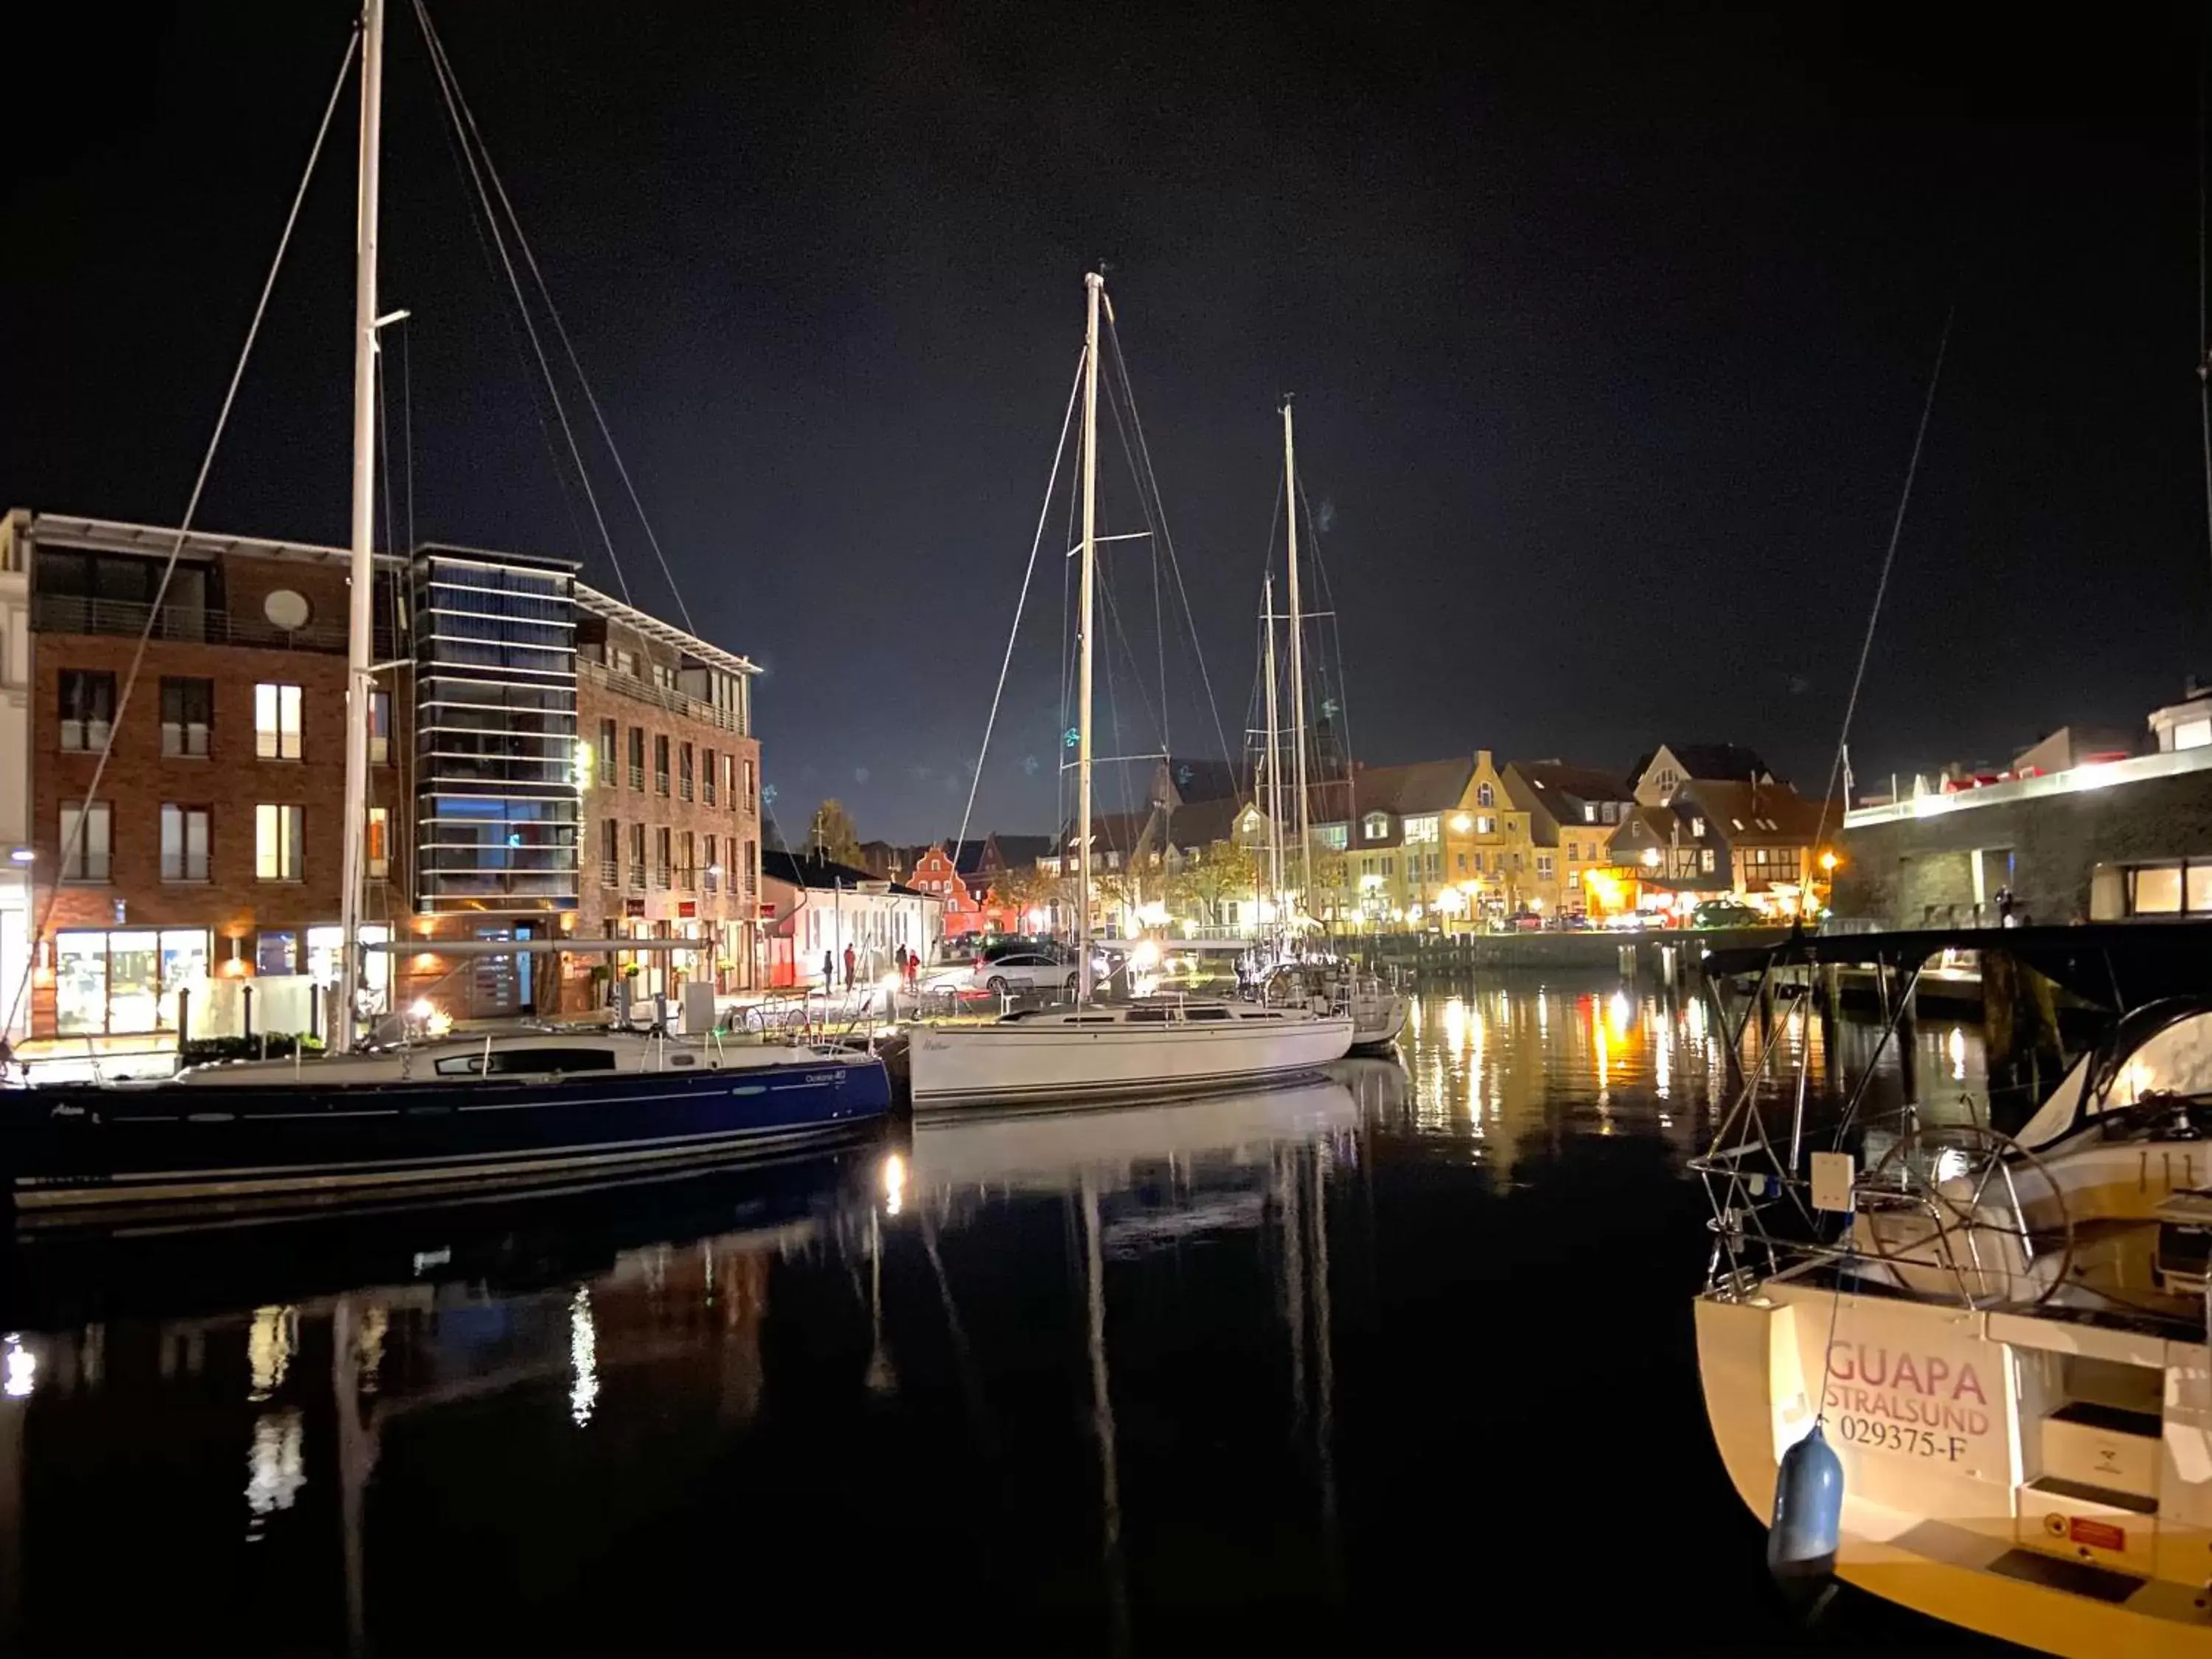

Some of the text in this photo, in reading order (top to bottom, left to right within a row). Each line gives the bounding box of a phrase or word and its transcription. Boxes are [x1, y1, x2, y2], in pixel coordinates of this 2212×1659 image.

[1827, 1340, 1988, 1405] GUAPA
[1826, 1383, 1989, 1436] STRALSUND
[1840, 1414, 1968, 1462] 029375-F
